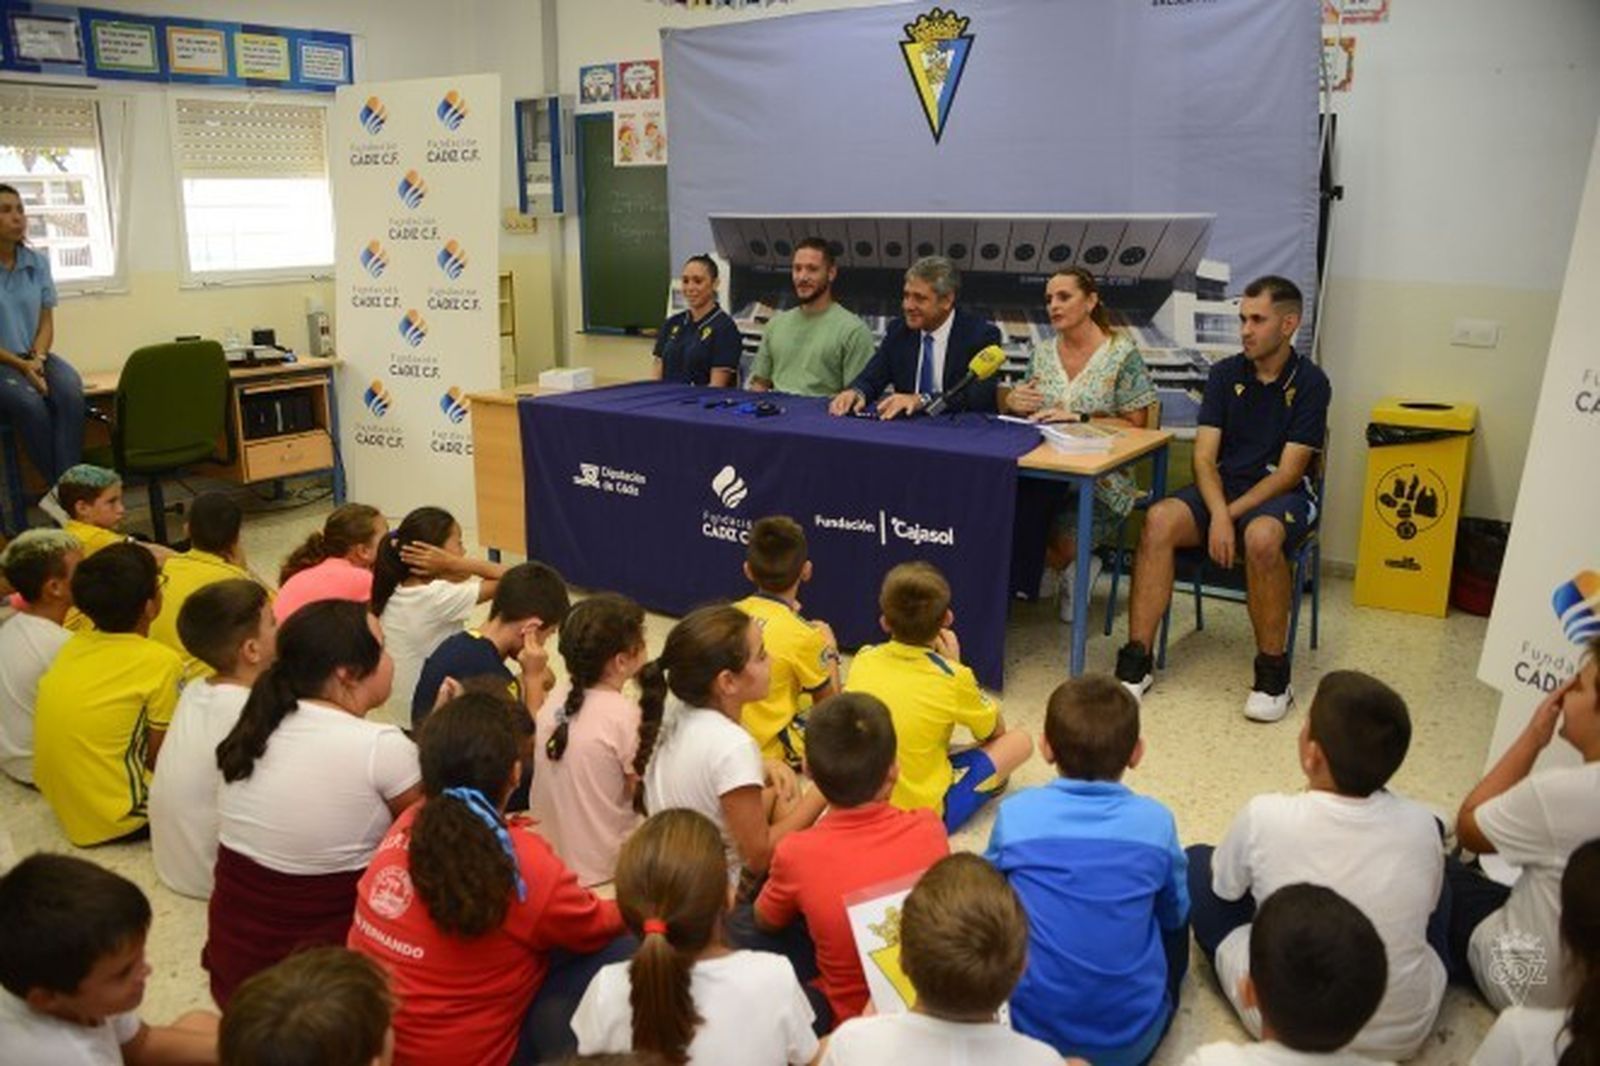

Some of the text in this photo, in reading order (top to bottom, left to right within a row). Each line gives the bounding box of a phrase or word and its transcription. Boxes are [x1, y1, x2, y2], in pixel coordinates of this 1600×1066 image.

[815, 515, 953, 545] Fundación Cajasol
[1522, 641, 1575, 675] Funda
